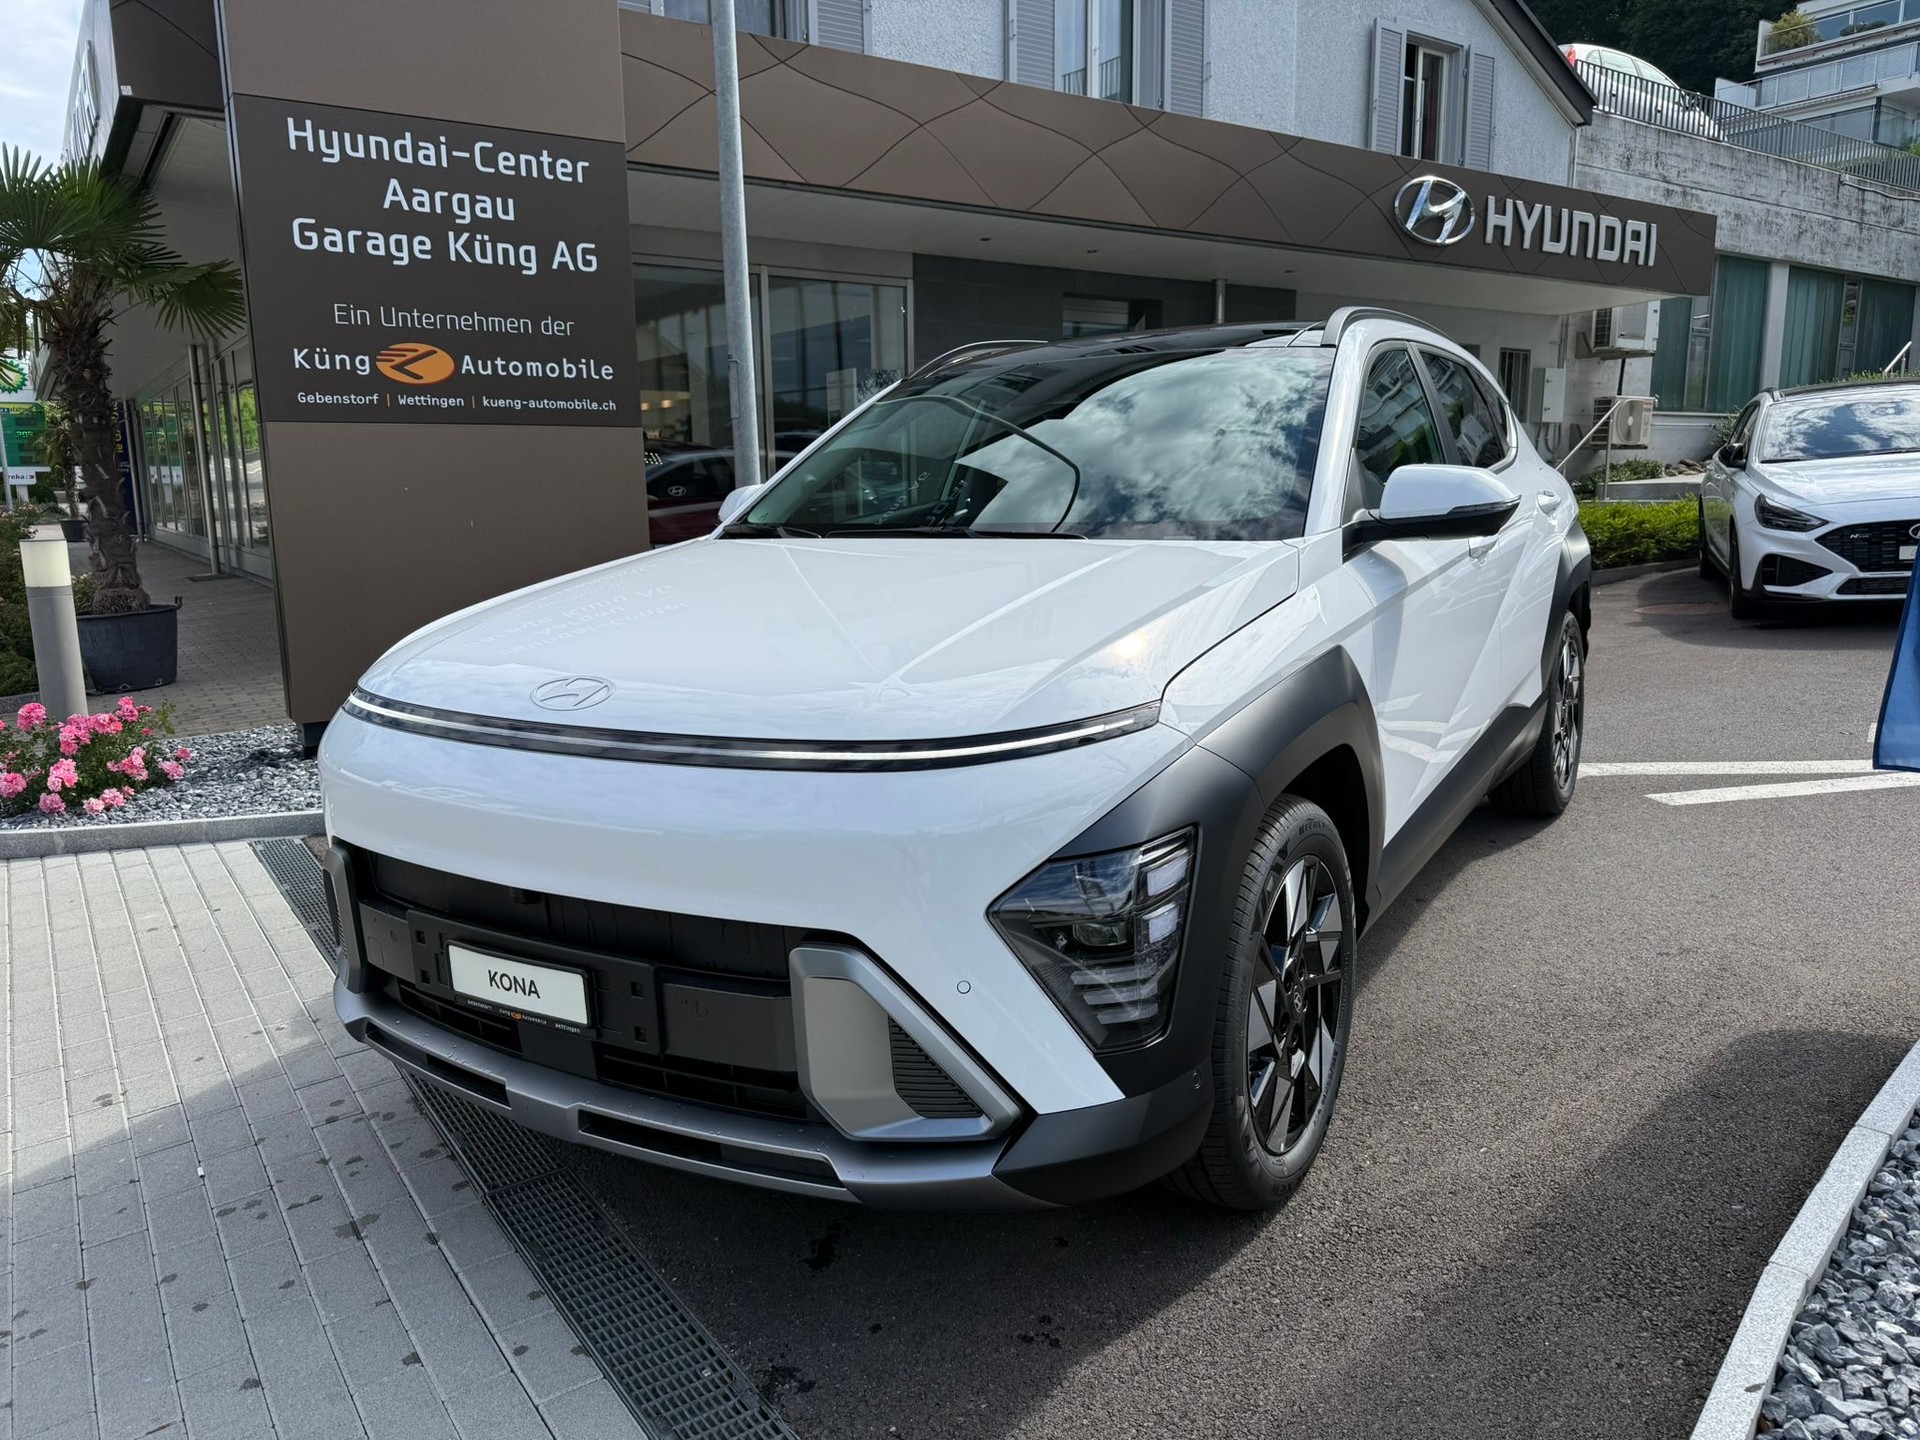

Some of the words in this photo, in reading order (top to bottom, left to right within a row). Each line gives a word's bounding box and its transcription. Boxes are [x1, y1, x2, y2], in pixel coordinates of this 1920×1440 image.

[287, 117, 590, 183] Hyundai-Center
[383, 178, 516, 224] Aargau
[292, 217, 432, 266] Garage
[448, 231, 538, 275] Küng
[551, 240, 598, 273] AG
[1485, 195, 1658, 267] HYUNDAI
[334, 303, 371, 326] Ein
[380, 306, 533, 335] Unternehmen
[541, 316, 575, 336] der
[293, 347, 371, 376] Küng
[461, 354, 615, 380] Automobile
[297, 392, 379, 406] Gebenstorf
[398, 394, 465, 408] Wettingen
[482, 396, 617, 412] kueng-automobile.ch
[488, 969, 541, 999] KONA
